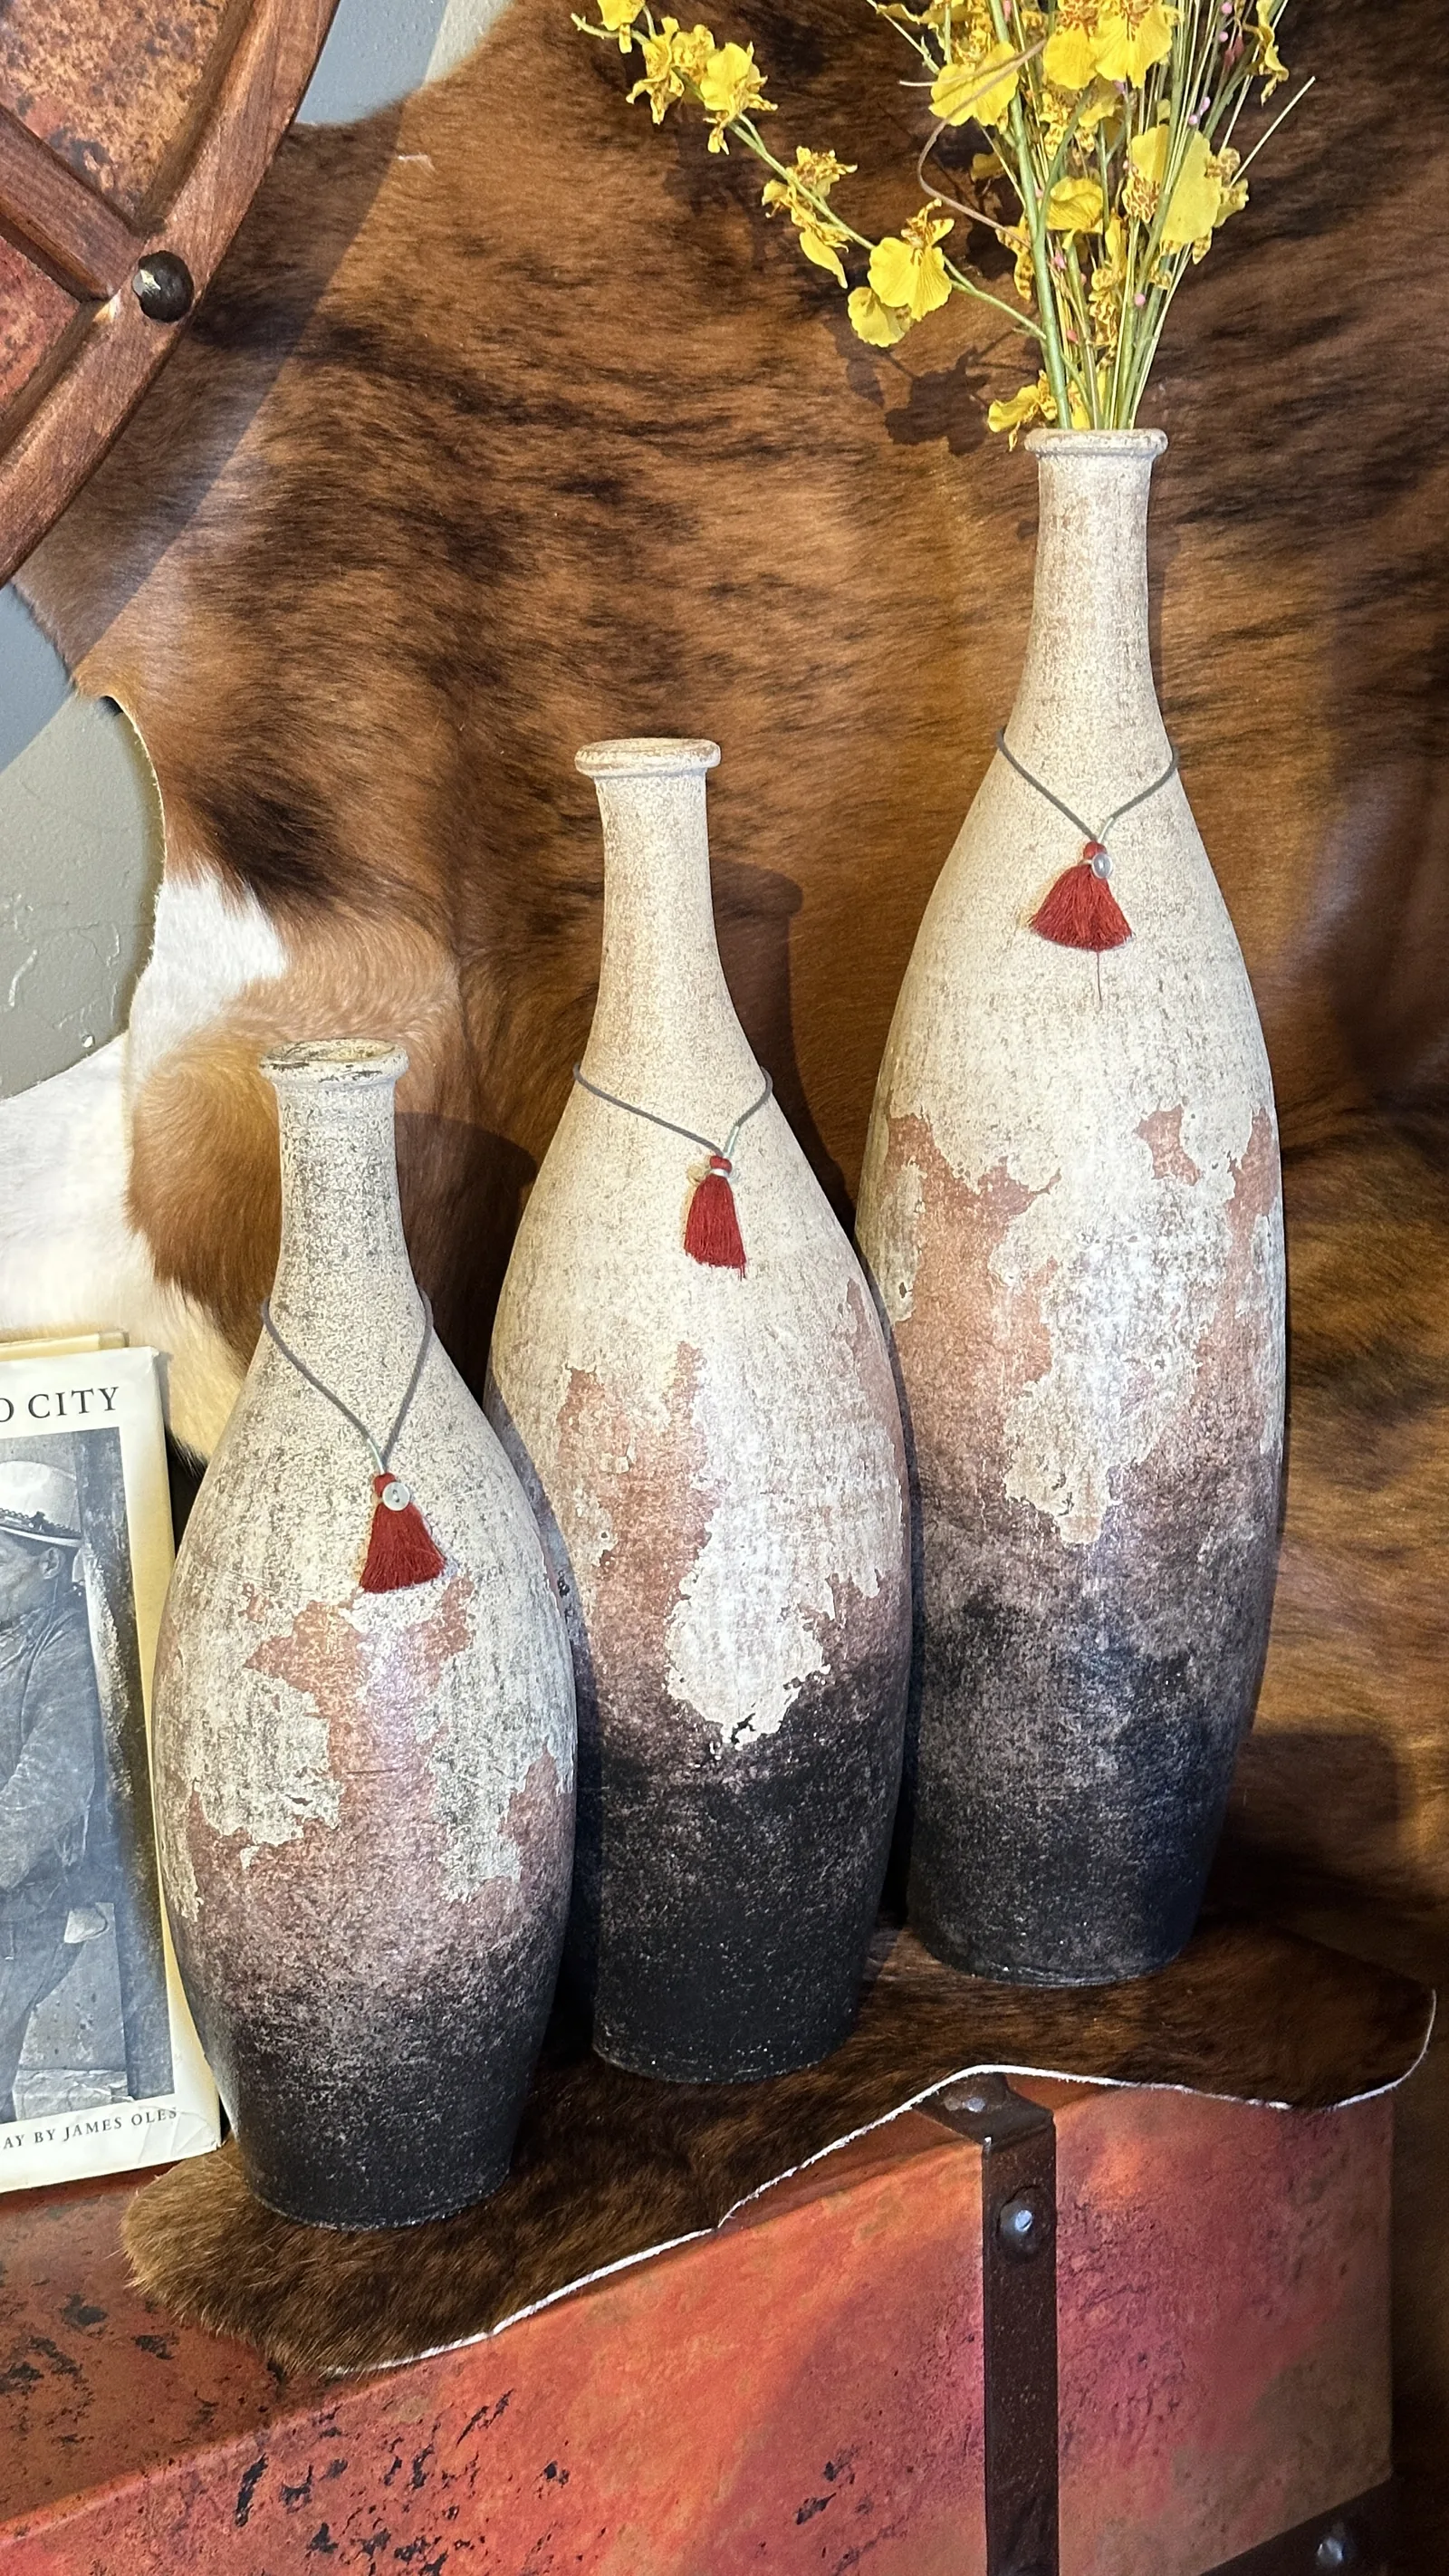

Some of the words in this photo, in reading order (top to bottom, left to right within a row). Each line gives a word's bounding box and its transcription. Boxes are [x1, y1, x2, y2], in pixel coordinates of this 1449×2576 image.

[28, 1386, 120, 1418] CITY
[34, 2128, 56, 2143] BY
[63, 2117, 122, 2142] JAMES
[131, 2108, 178, 2127] OLES
